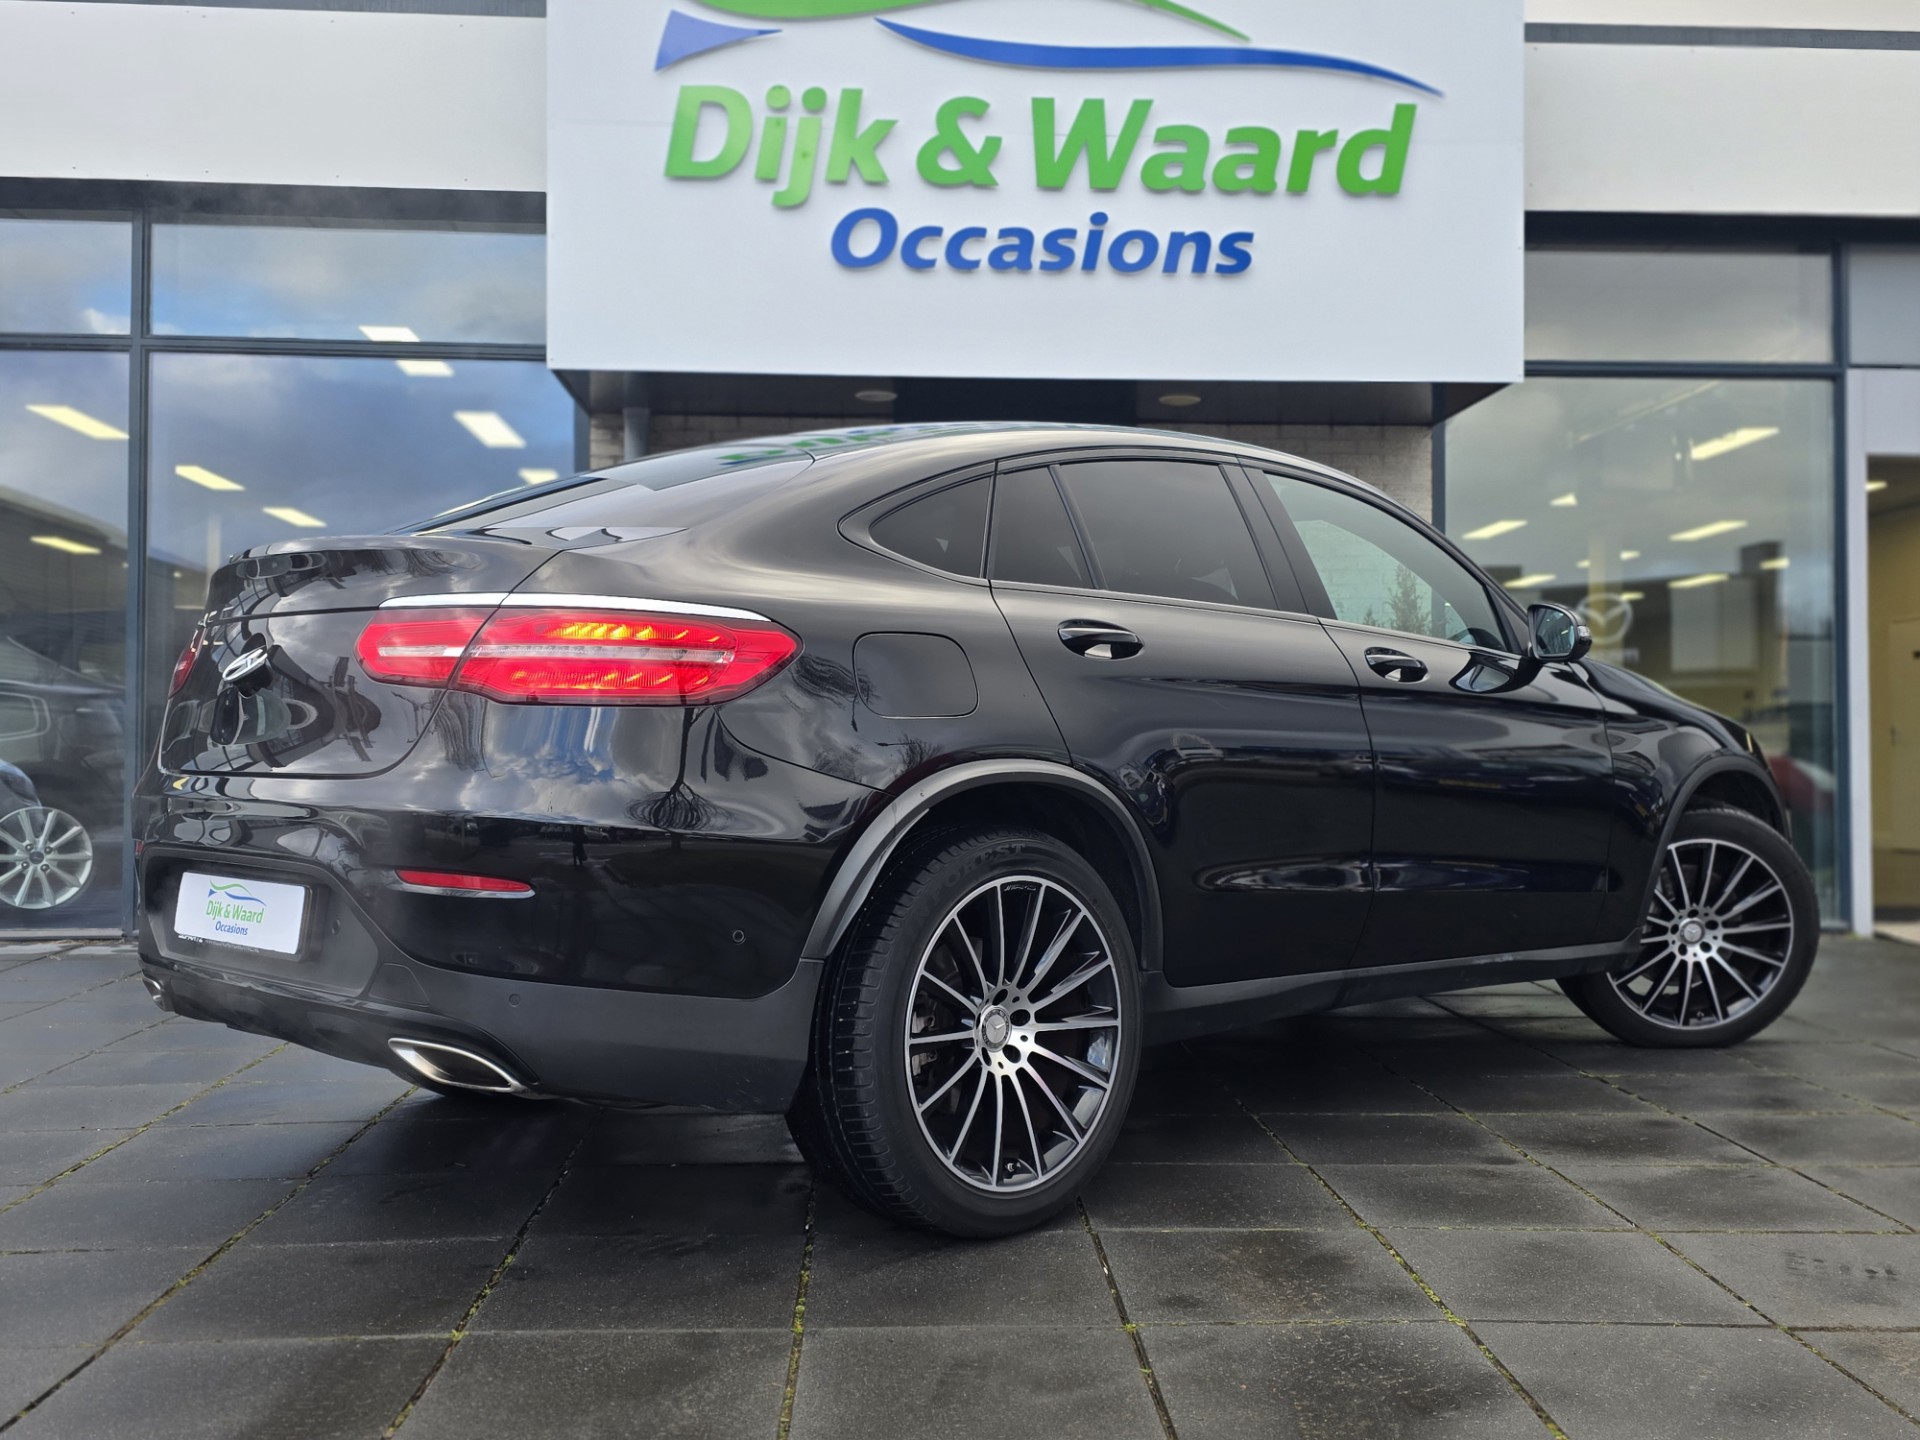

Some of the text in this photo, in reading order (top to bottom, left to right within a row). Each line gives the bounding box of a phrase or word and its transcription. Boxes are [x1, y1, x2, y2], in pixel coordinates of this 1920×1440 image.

[666, 86, 1417, 207] Dijk & Waard
[831, 207, 1255, 276] Occasions
[206, 899, 265, 923] Dijk & Waard
[215, 920, 248, 935] Occasions
